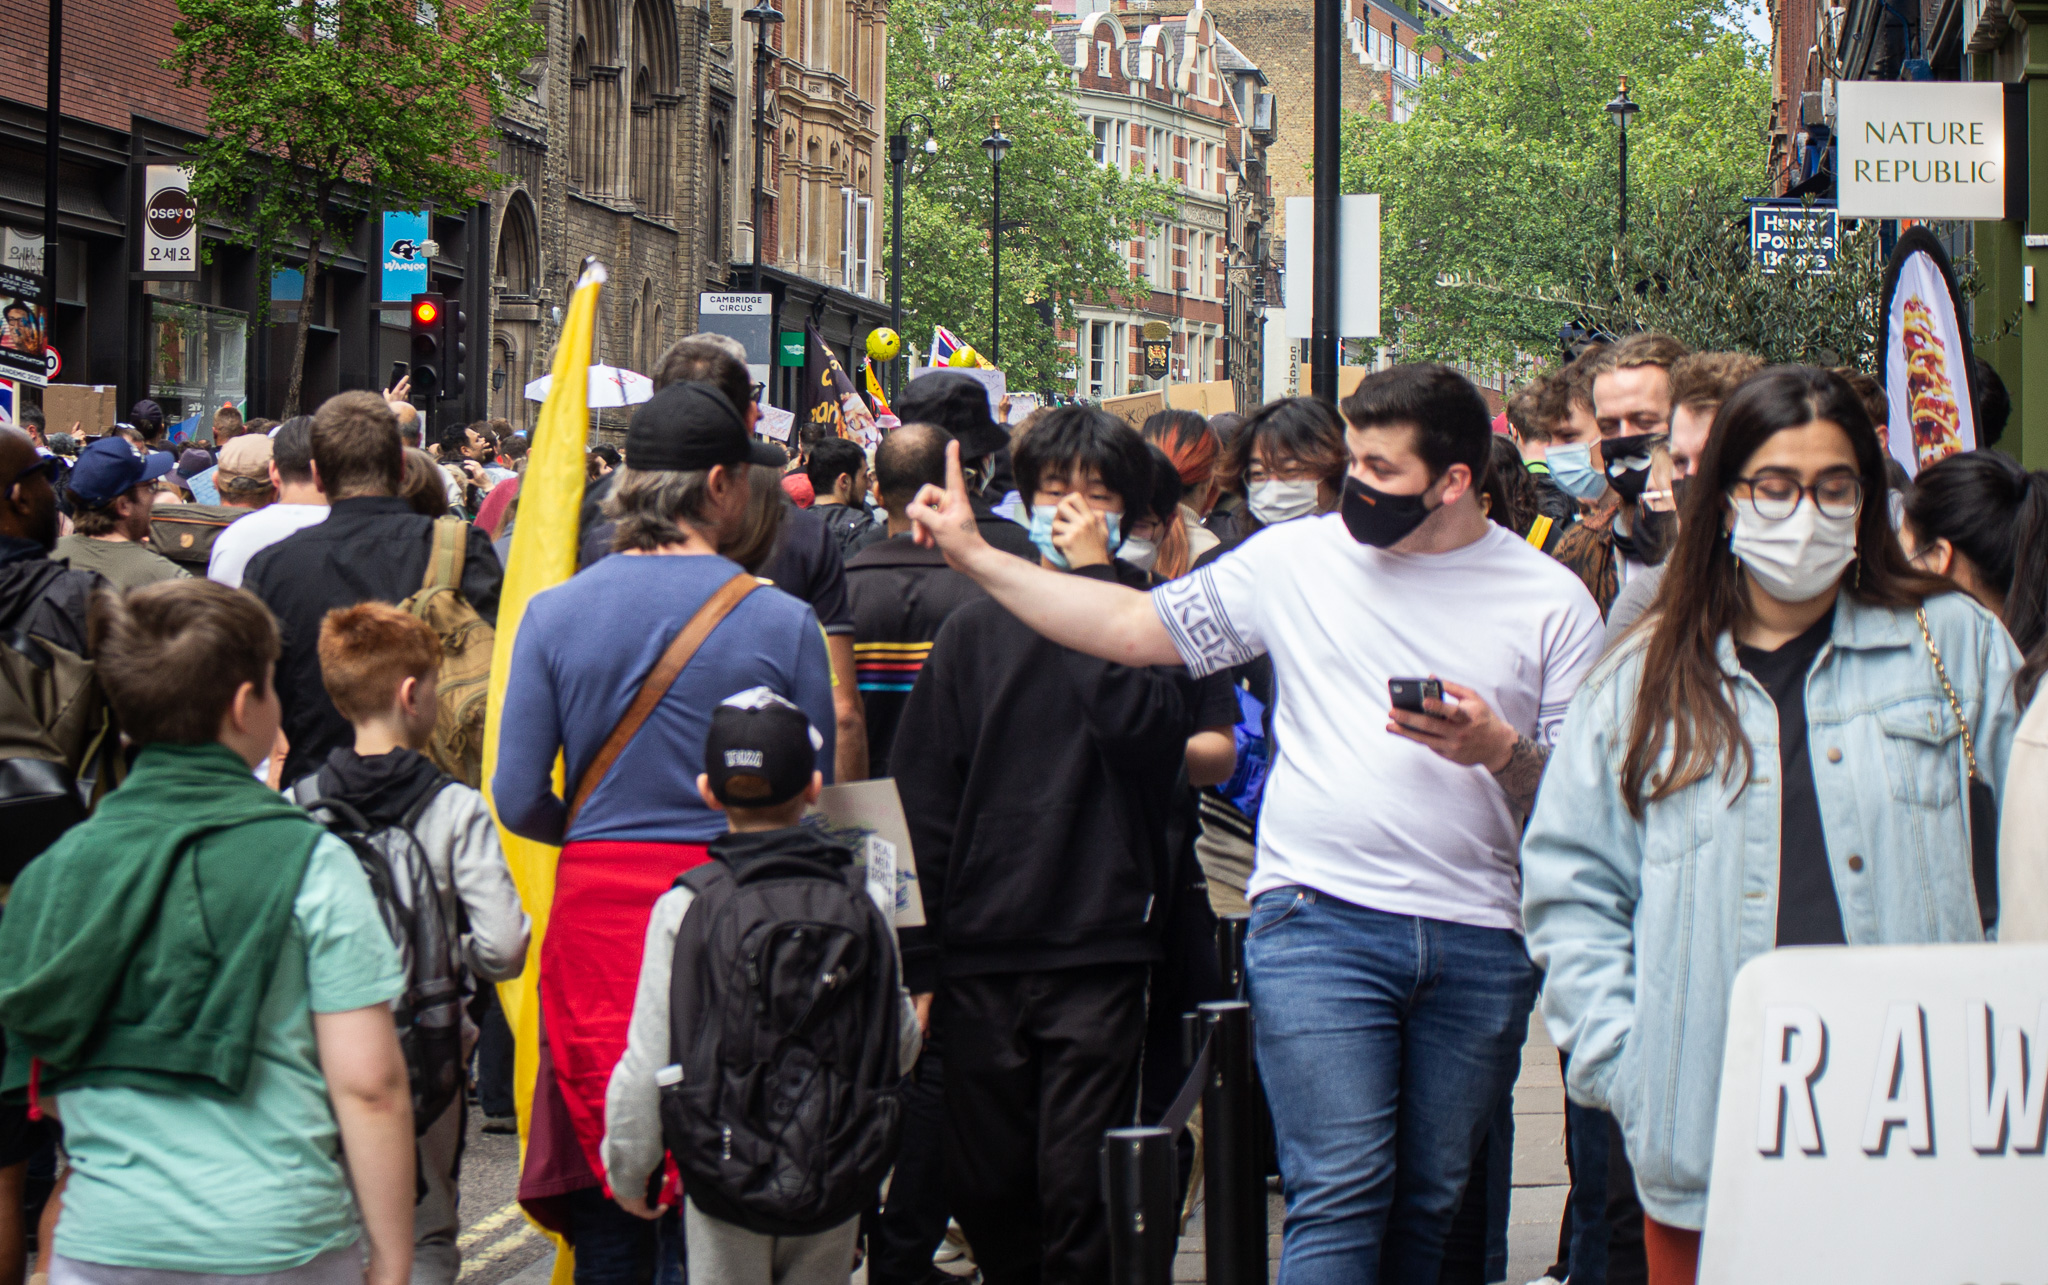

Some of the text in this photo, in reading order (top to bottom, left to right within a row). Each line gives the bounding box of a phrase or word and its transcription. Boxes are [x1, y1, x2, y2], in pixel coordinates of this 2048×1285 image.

[1865, 121, 1985, 145] NATURE
[1854, 159, 1997, 184] REPUBLIC
[149, 208, 194, 224] oseyo
[148, 247, 192, 262] 오세요
[710, 296, 762, 304] CAMBRIDGE
[719, 304, 753, 312] CIRCUS
[1756, 1000, 2048, 1158] RAW
